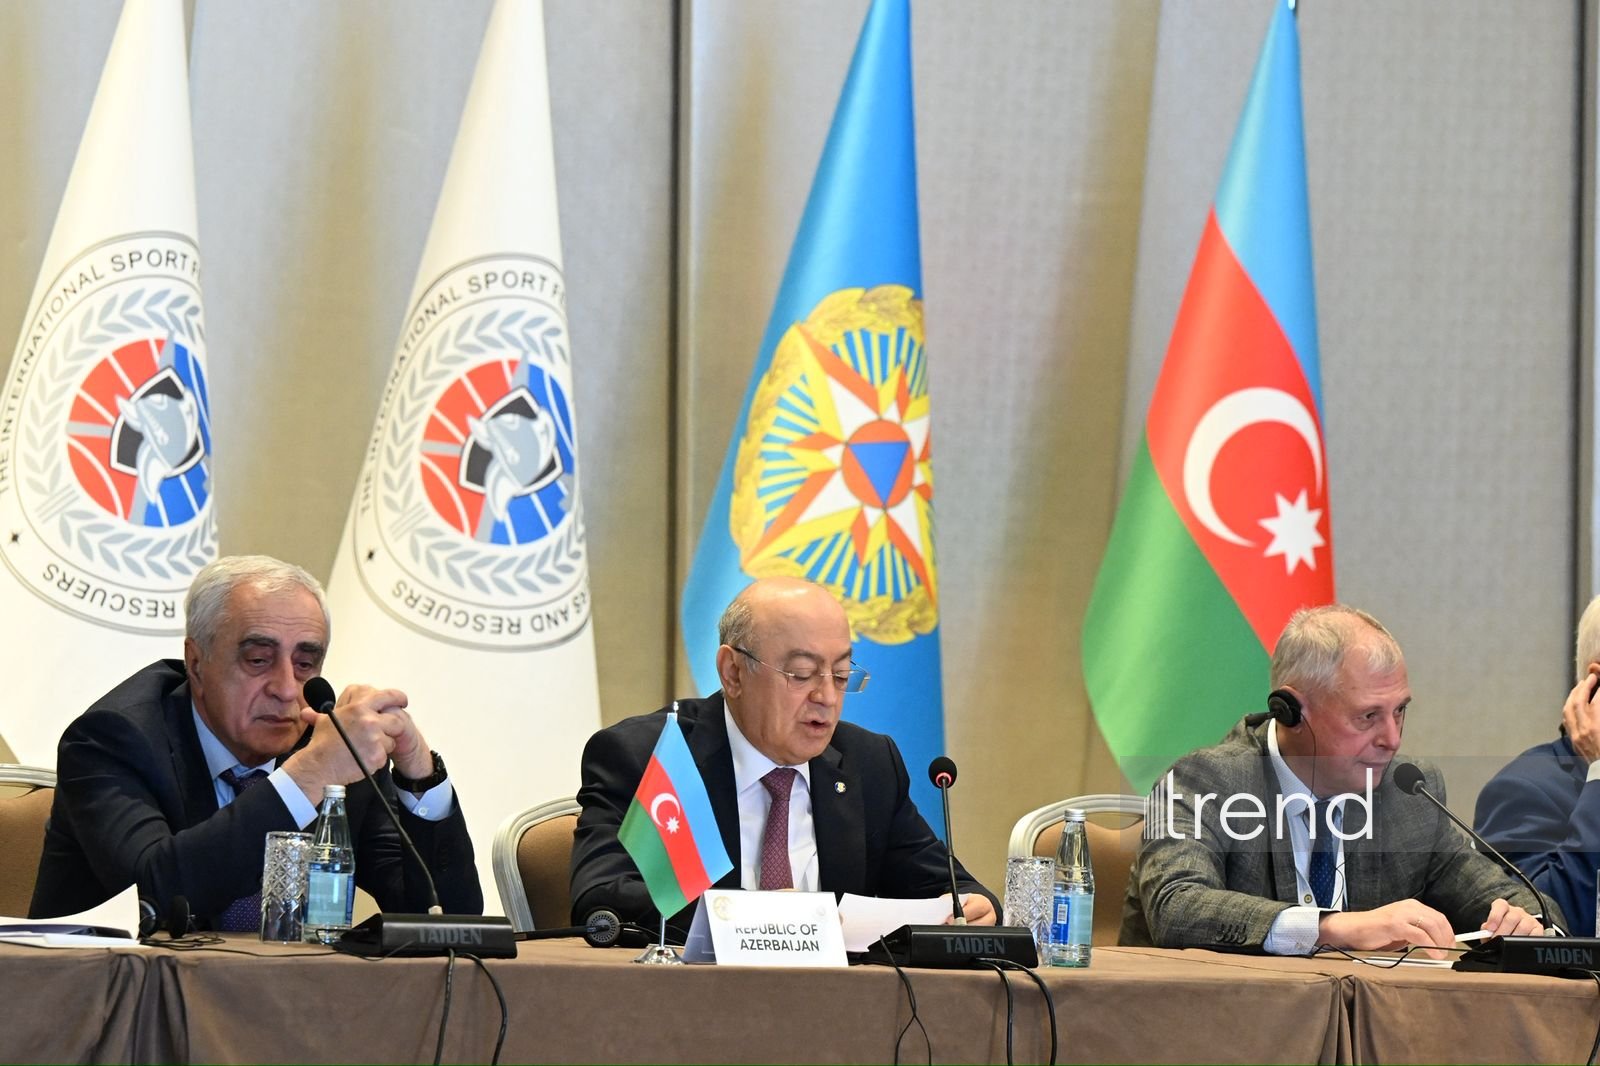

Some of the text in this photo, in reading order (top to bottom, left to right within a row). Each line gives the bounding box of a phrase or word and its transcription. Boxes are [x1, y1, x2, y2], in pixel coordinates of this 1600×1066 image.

[468, 270, 548, 295] SPORT
[0, 265, 105, 442] INTERNATIONAL
[111, 248, 189, 273] SPORT
[43, 563, 176, 619] RESCUERS
[392, 580, 522, 635] RESCUERS
[530, 607, 569, 633] AND
[417, 927, 483, 945] TAIDEN
[800, 923, 818, 936] OF
[740, 939, 820, 952] AZERBAIJAN
[943, 936, 1006, 955] TAIDEN
[1534, 947, 1593, 965] TAIDEN
